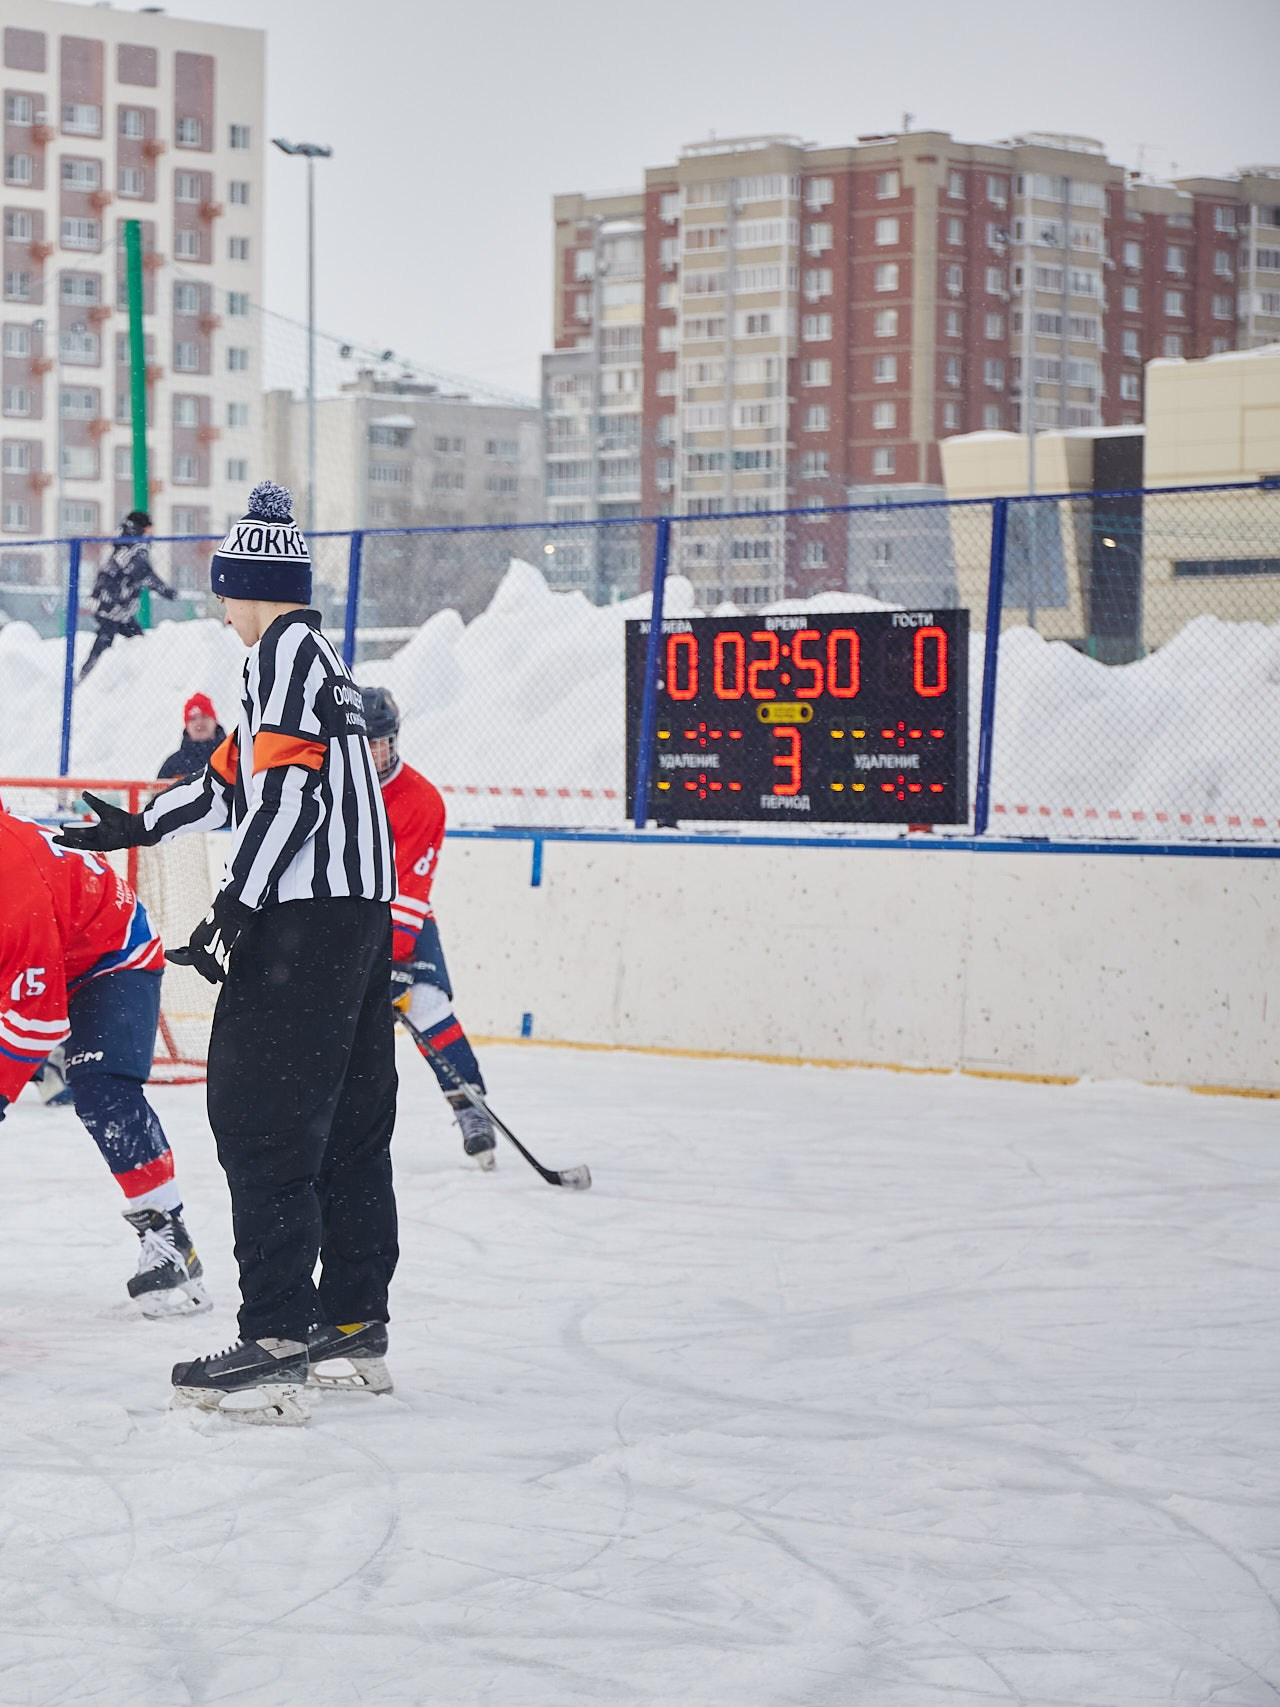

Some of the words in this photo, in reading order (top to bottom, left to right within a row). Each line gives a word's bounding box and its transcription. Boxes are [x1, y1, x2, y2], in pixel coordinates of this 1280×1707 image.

[639, 620, 693, 634] ХЯЕВА
[765, 616, 808, 631] ВРЕМЯ
[892, 613, 934, 628] ГОСТИ
[667, 633, 698, 700] 0
[714, 629, 860, 700] 02:50
[913, 626, 948, 697] 0
[658, 754, 720, 769] УДАЛЕНИЕ
[772, 726, 802, 796] 3
[853, 754, 920, 769] УДАЛЕНИЕ
[760, 795, 811, 810] ПЕРИОД
[10, 966, 47, 1001] 15
